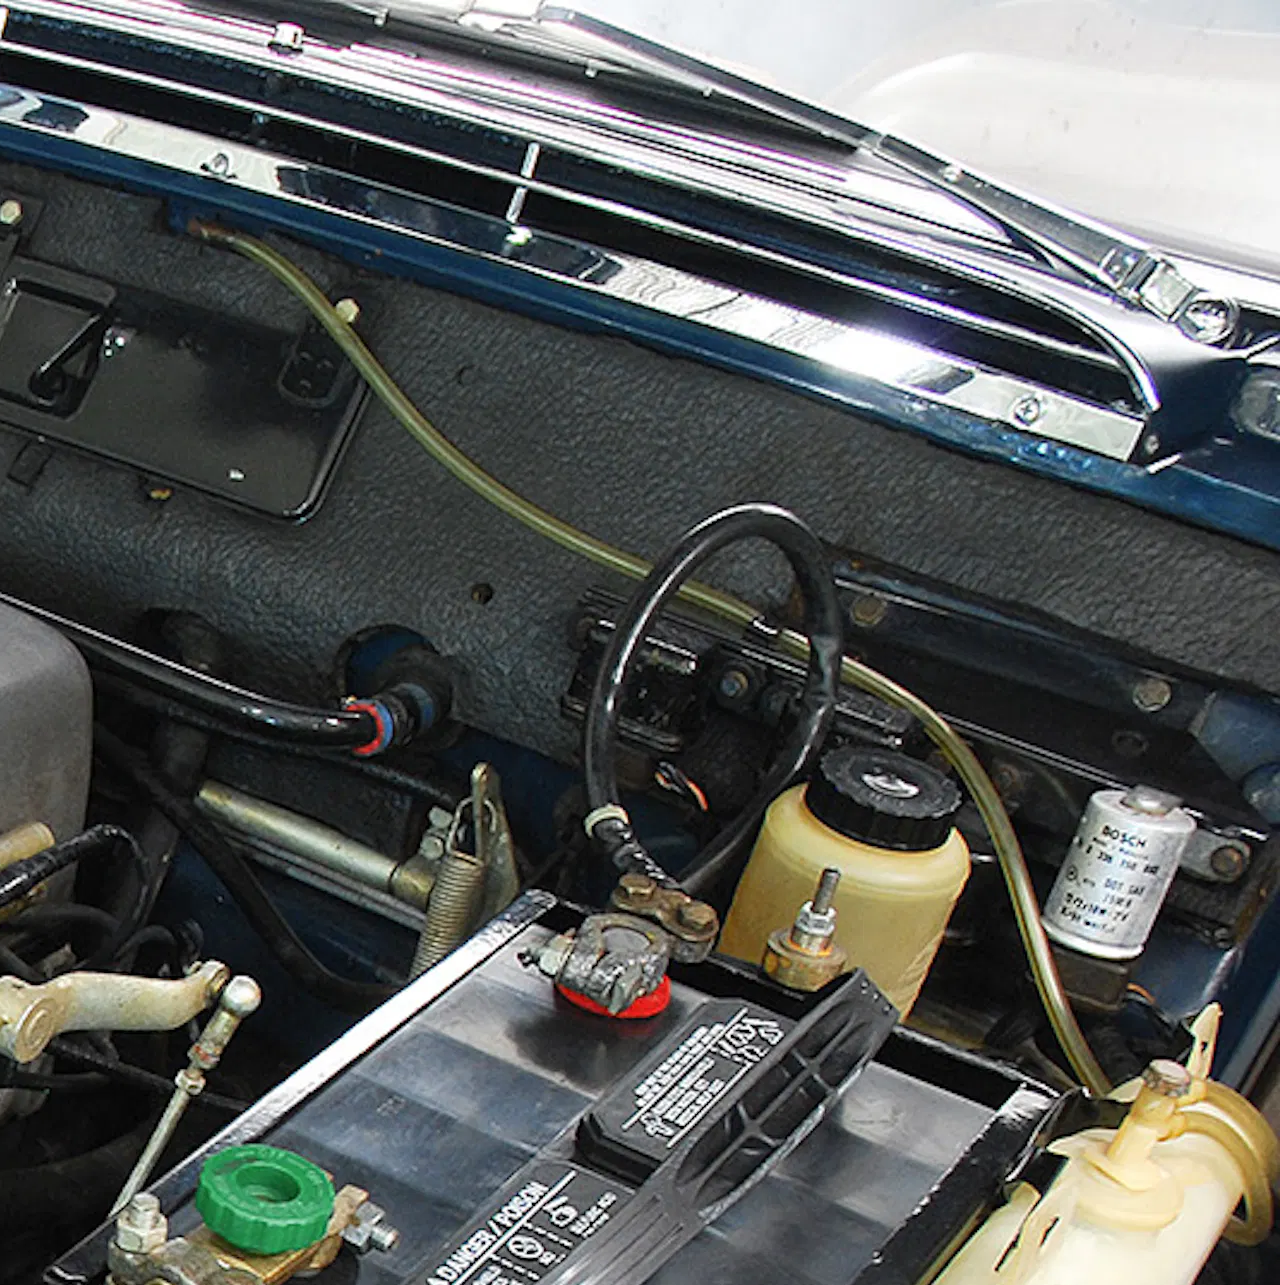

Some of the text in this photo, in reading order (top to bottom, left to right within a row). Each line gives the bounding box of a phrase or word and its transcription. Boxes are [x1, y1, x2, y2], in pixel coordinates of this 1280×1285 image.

[1102, 825, 1146, 848] BOSCH
[436, 1227, 497, 1282] DANGER
[492, 1181, 548, 1228] POISON
